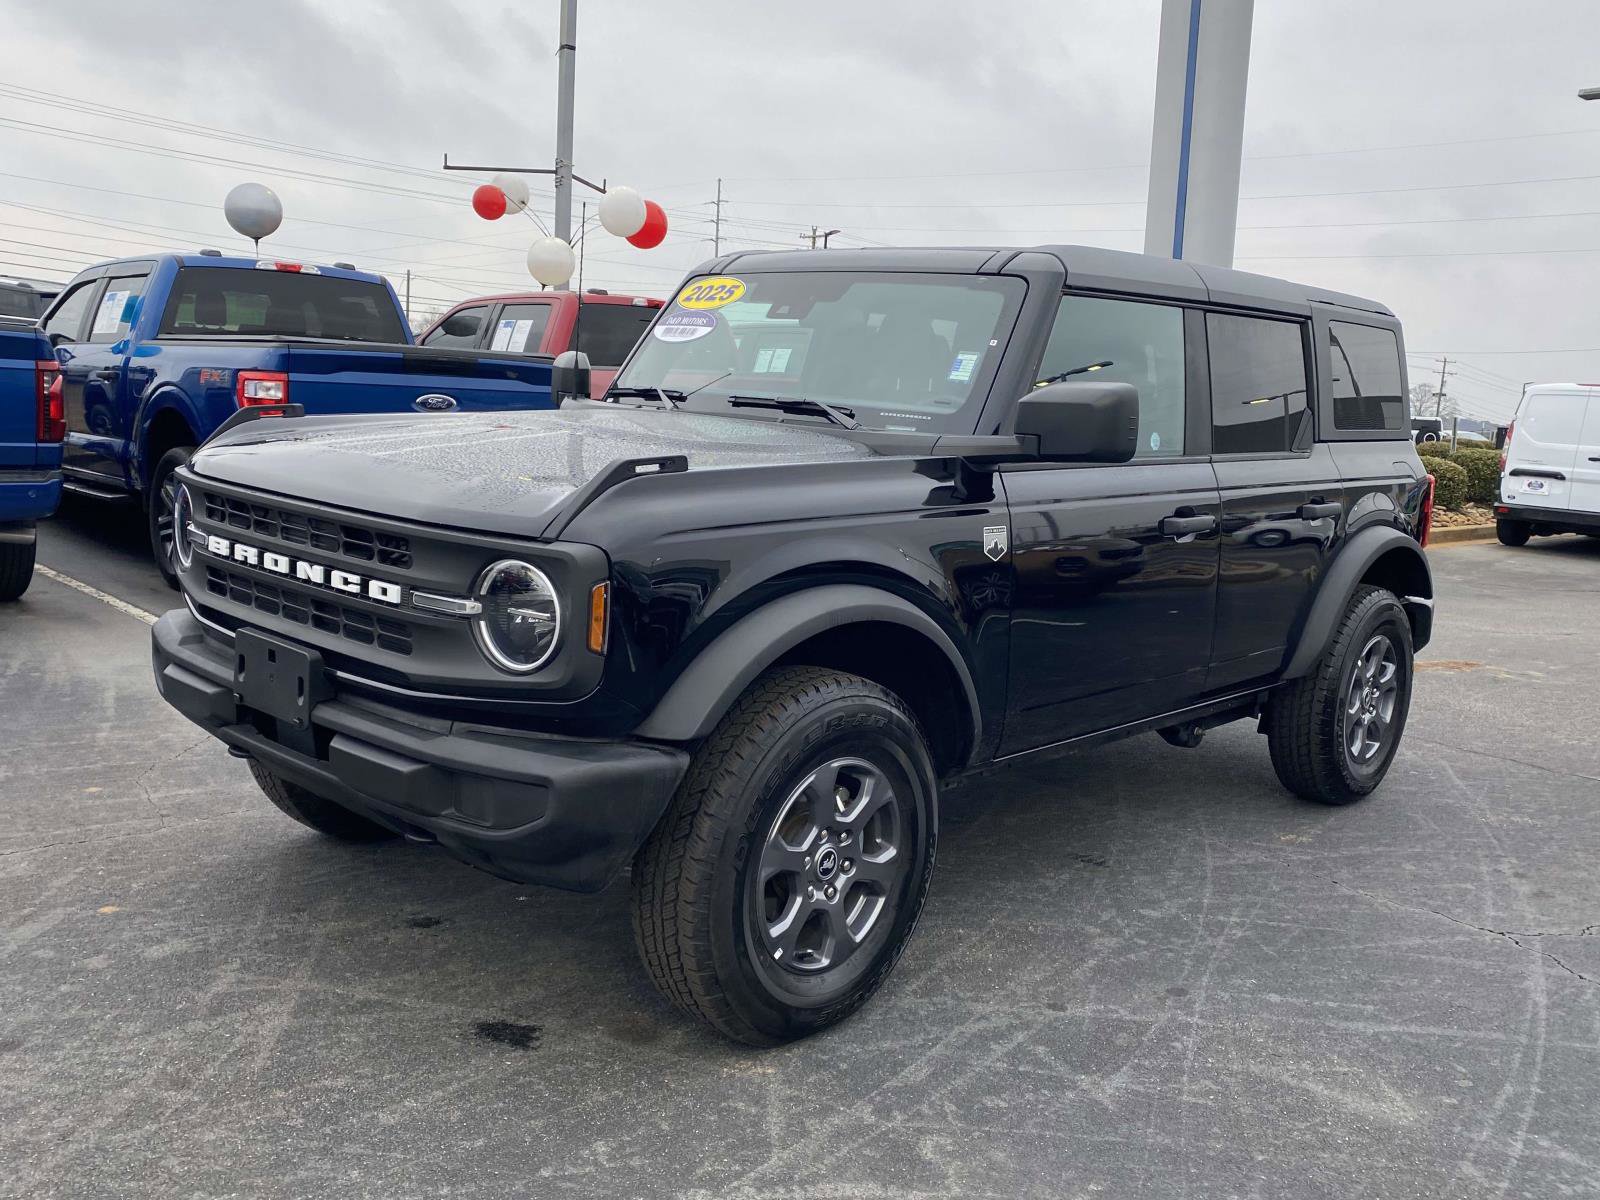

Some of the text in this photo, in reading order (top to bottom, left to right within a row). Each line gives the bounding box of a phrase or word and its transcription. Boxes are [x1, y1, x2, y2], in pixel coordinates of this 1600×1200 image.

[682, 284, 741, 302] 2025
[682, 316, 708, 326] MOTORS
[426, 397, 448, 409] Ford
[208, 535, 401, 604] BRONCO
